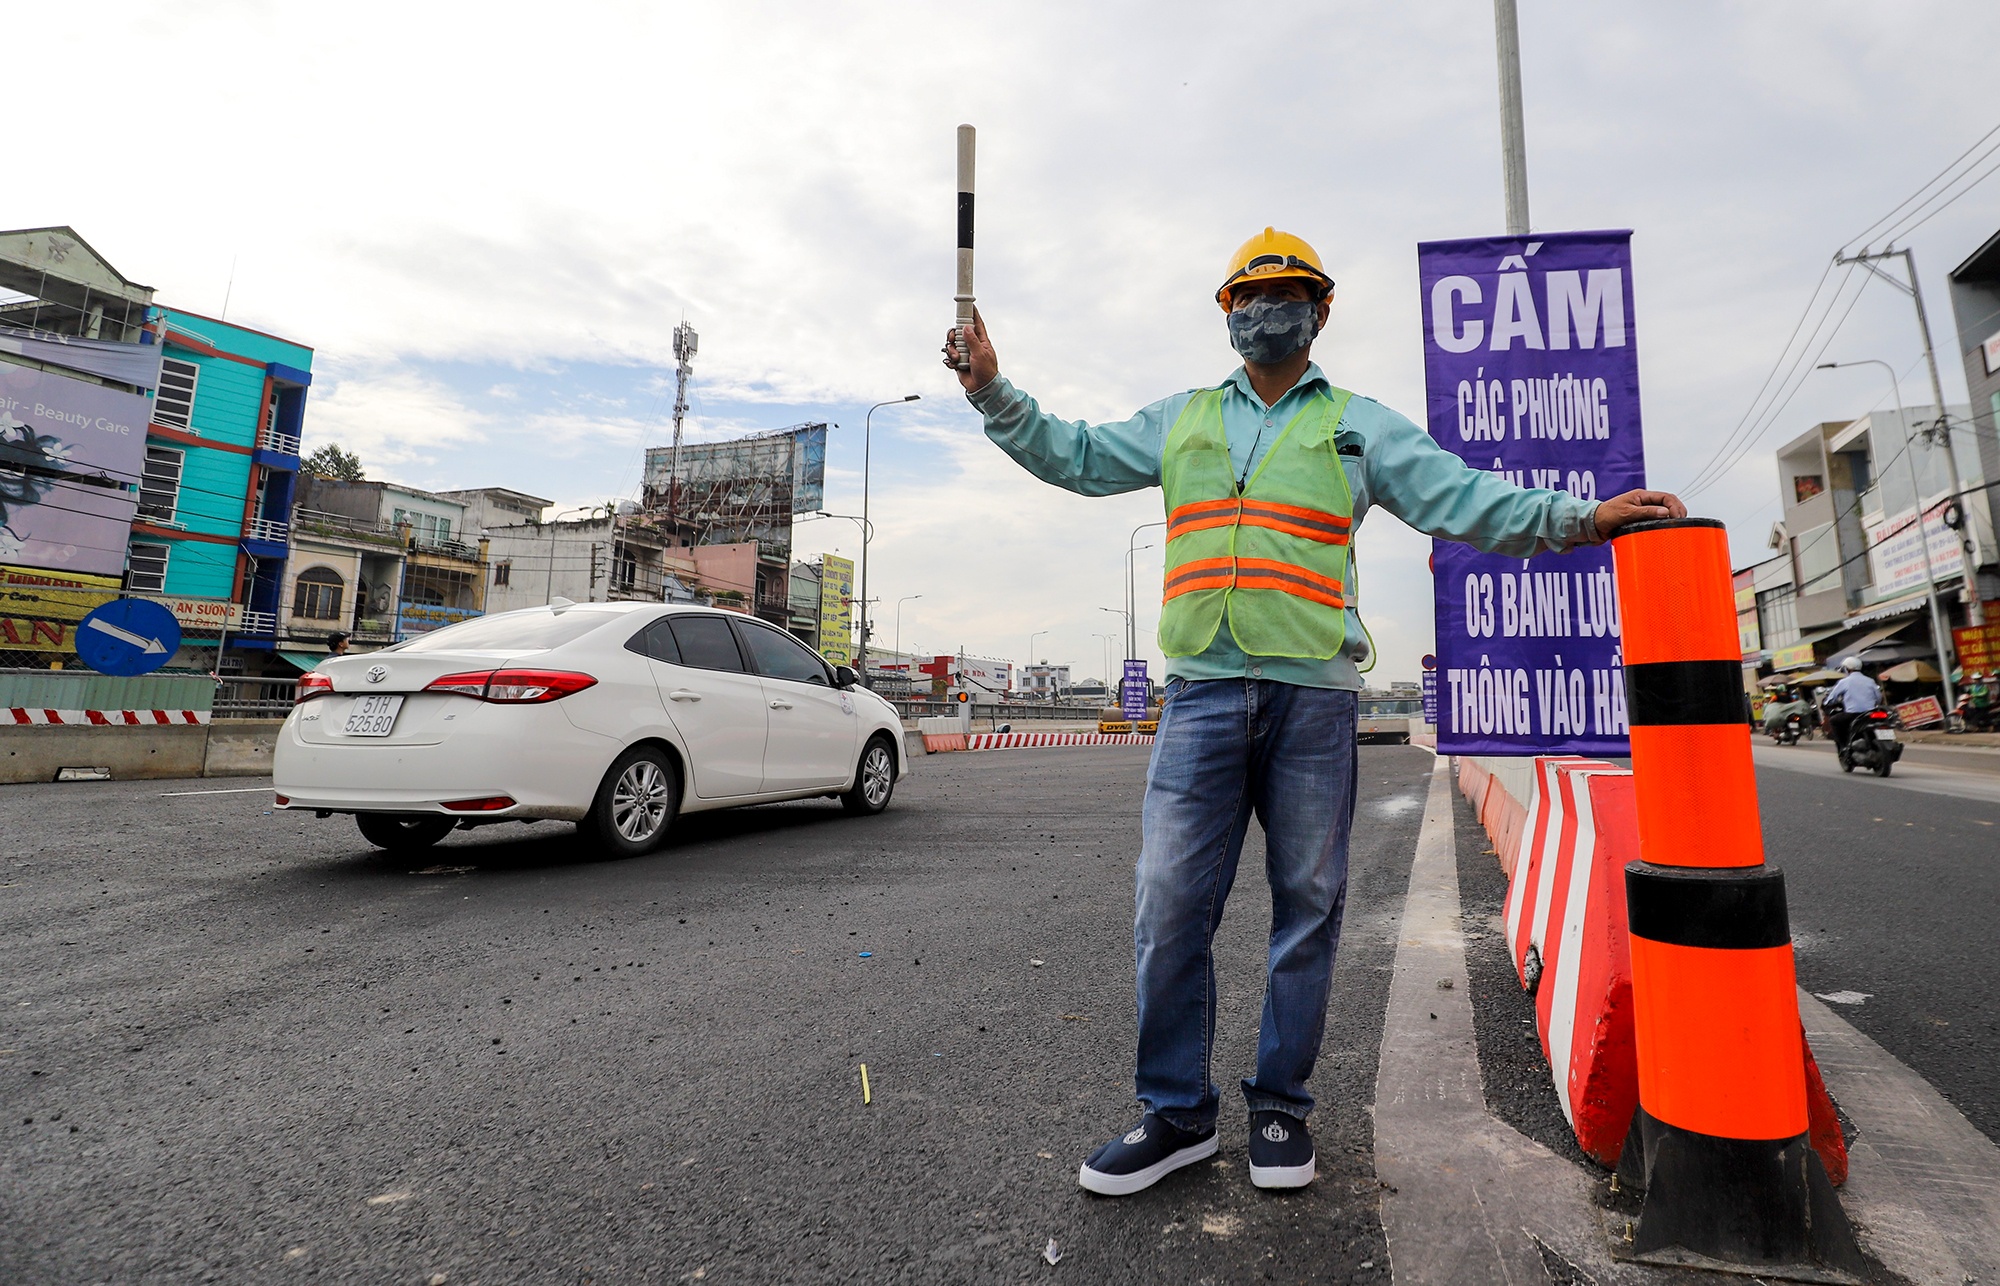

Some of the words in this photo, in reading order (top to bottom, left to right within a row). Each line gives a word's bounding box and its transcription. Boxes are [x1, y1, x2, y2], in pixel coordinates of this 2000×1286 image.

[1431, 242, 1626, 353] CẤM
[34, 403, 92, 429] Beauty
[95, 418, 130, 435] Care
[1457, 367, 1506, 442] CÁC
[1511, 373, 1610, 441] PHƯƠNG
[176, 603, 193, 614] AN
[196, 604, 236, 617] SƯƠNG
[1465, 573, 1495, 638] 03
[1501, 559, 1571, 638] BÁNH
[363, 696, 392, 714] 51H
[1448, 655, 1531, 736] THÔNG
[1536, 655, 1587, 736] VÀO
[1592, 645, 1630, 736] HẦ
[345, 715, 393, 733] 525.80
